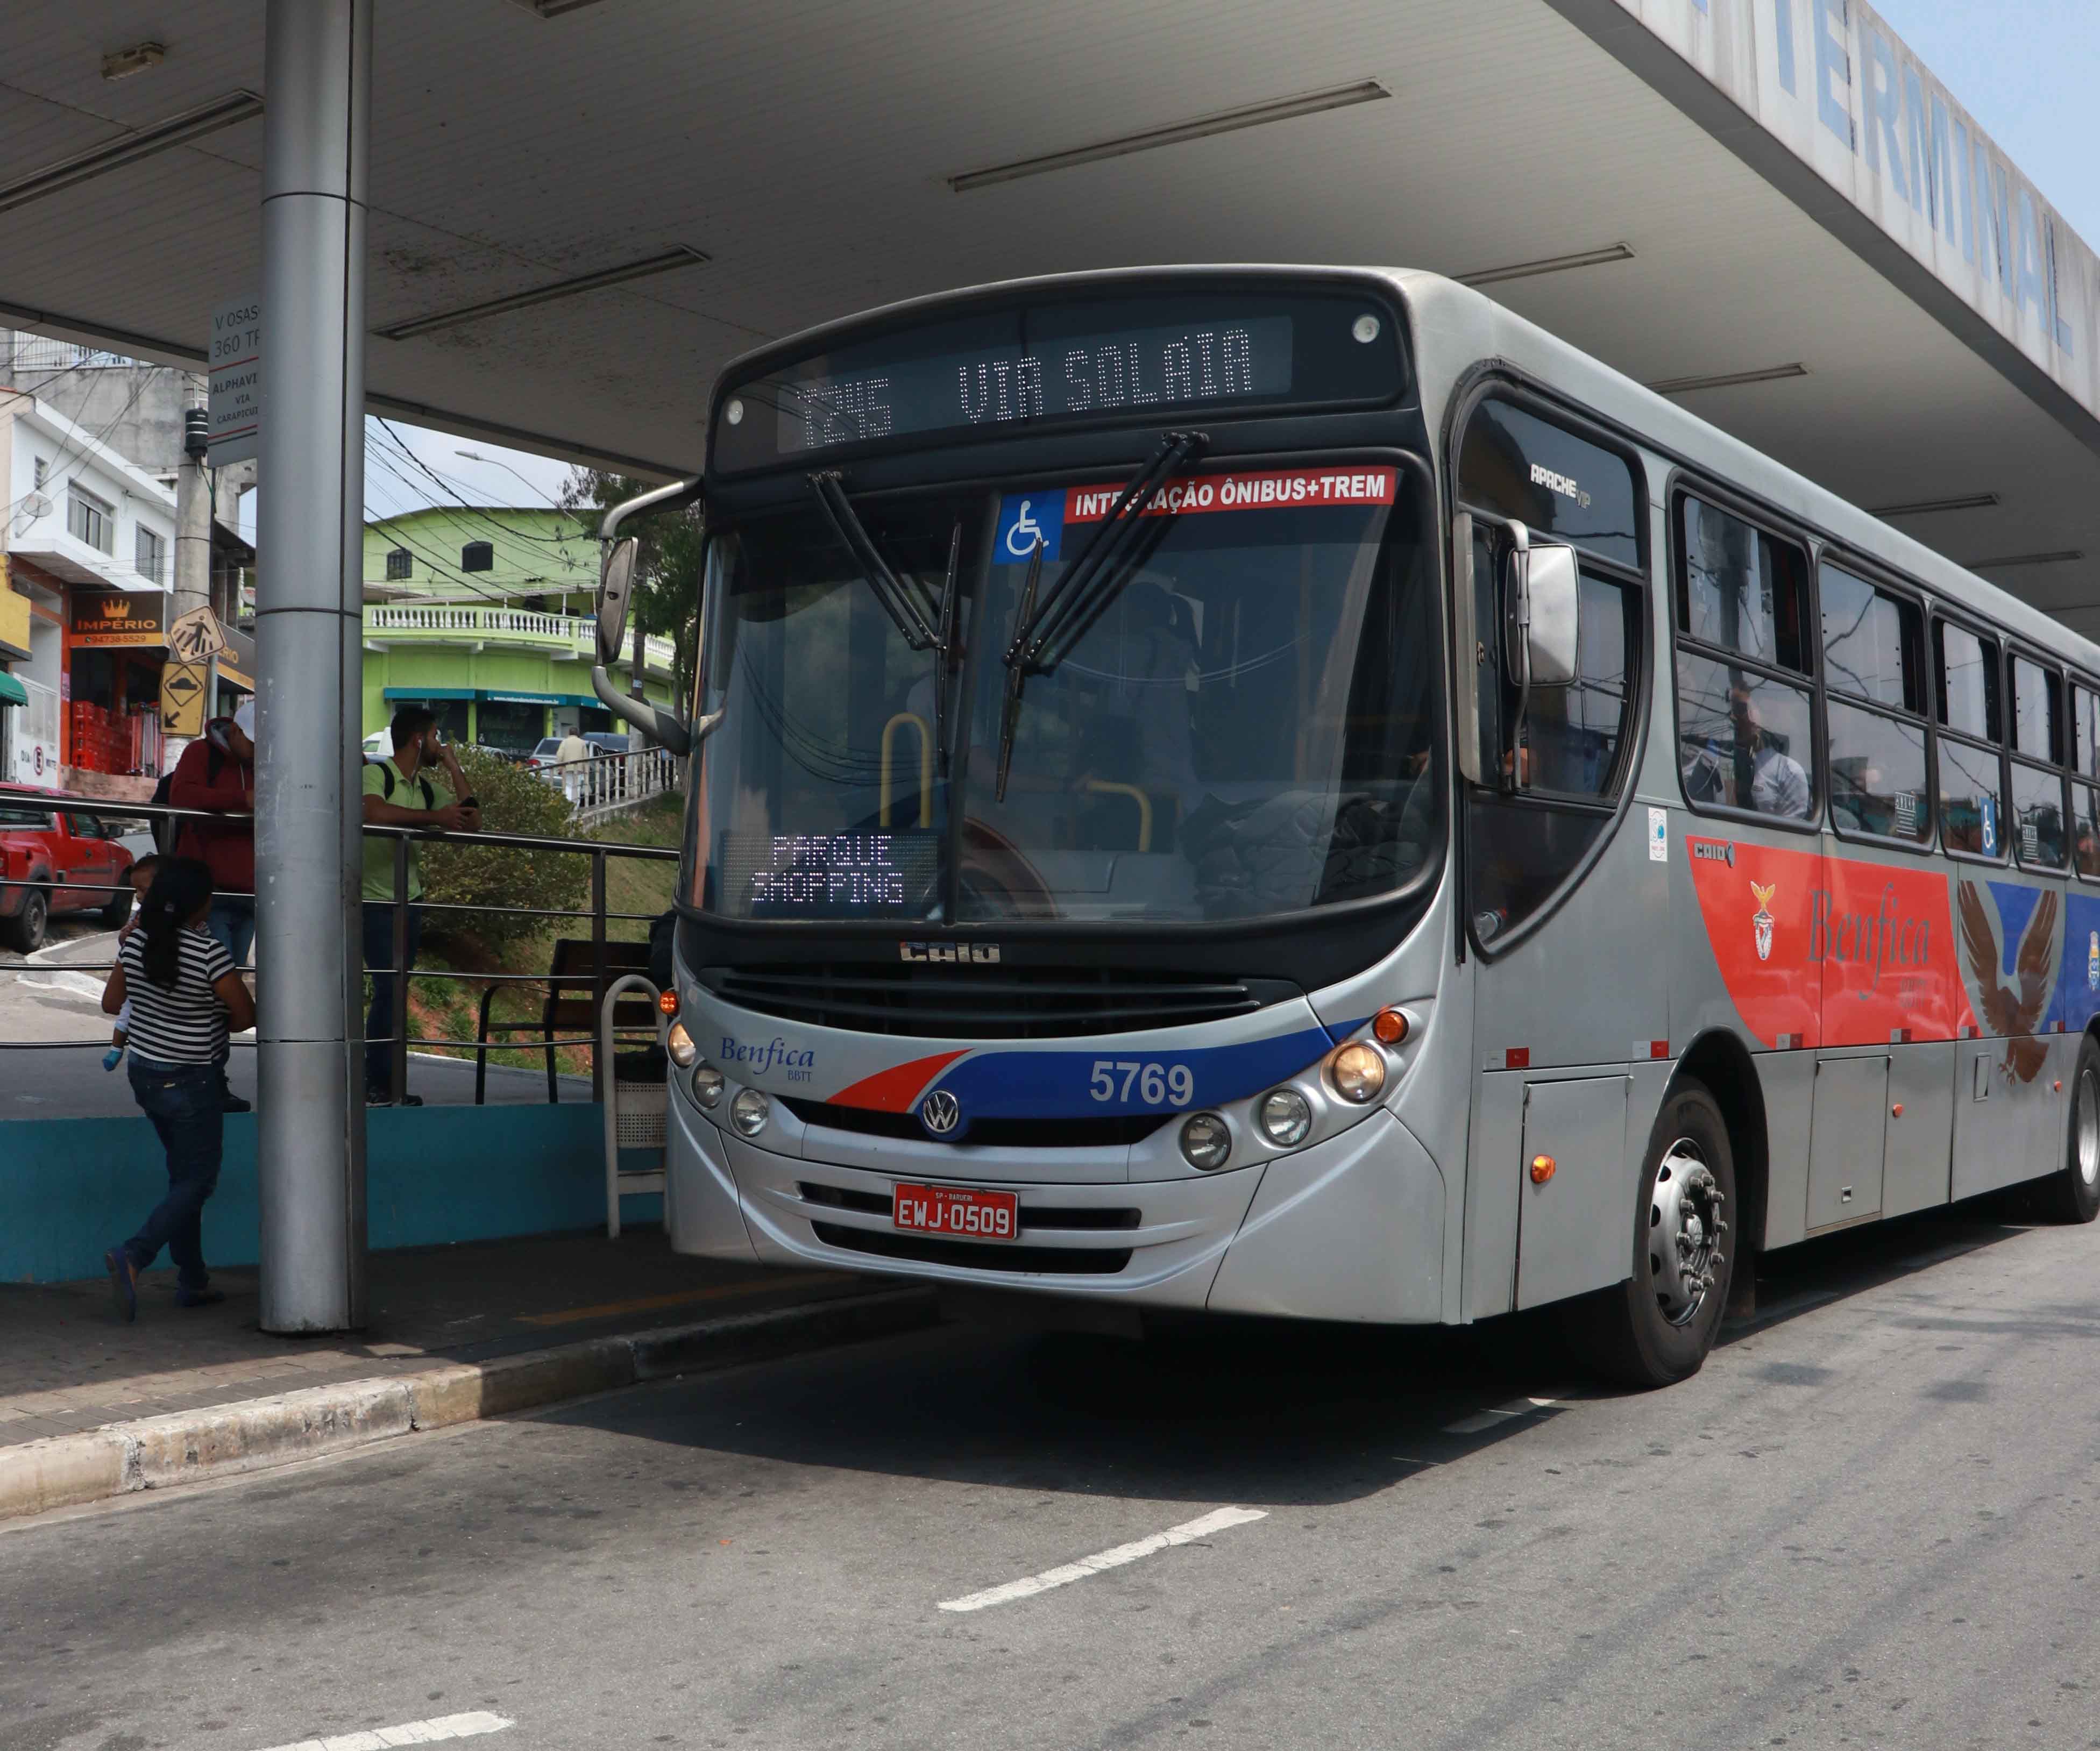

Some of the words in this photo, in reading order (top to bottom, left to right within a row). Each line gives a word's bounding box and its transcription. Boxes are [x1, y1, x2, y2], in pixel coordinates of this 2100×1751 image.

[227, 305, 261, 328] OSAS
[214, 336, 240, 358] 360
[235, 393, 251, 405] VIA
[959, 357, 1042, 424] VIA
[1220, 478, 1386, 505] ÔNIBUS+TREM
[1530, 463, 1577, 499] APACHE
[76, 618, 158, 630] IMPÉRIO
[774, 835, 892, 866] PARQUE
[1694, 842, 1726, 861] CAIO
[751, 872, 903, 903] SHOPPING
[899, 942, 1001, 964] CAIO
[1805, 881, 1931, 1001] Benfica
[720, 1037, 814, 1075] Benfica
[788, 1070, 812, 1083] BBTT
[1089, 1060, 1194, 1106] 5769
[948, 1193, 973, 1202] BARUERI
